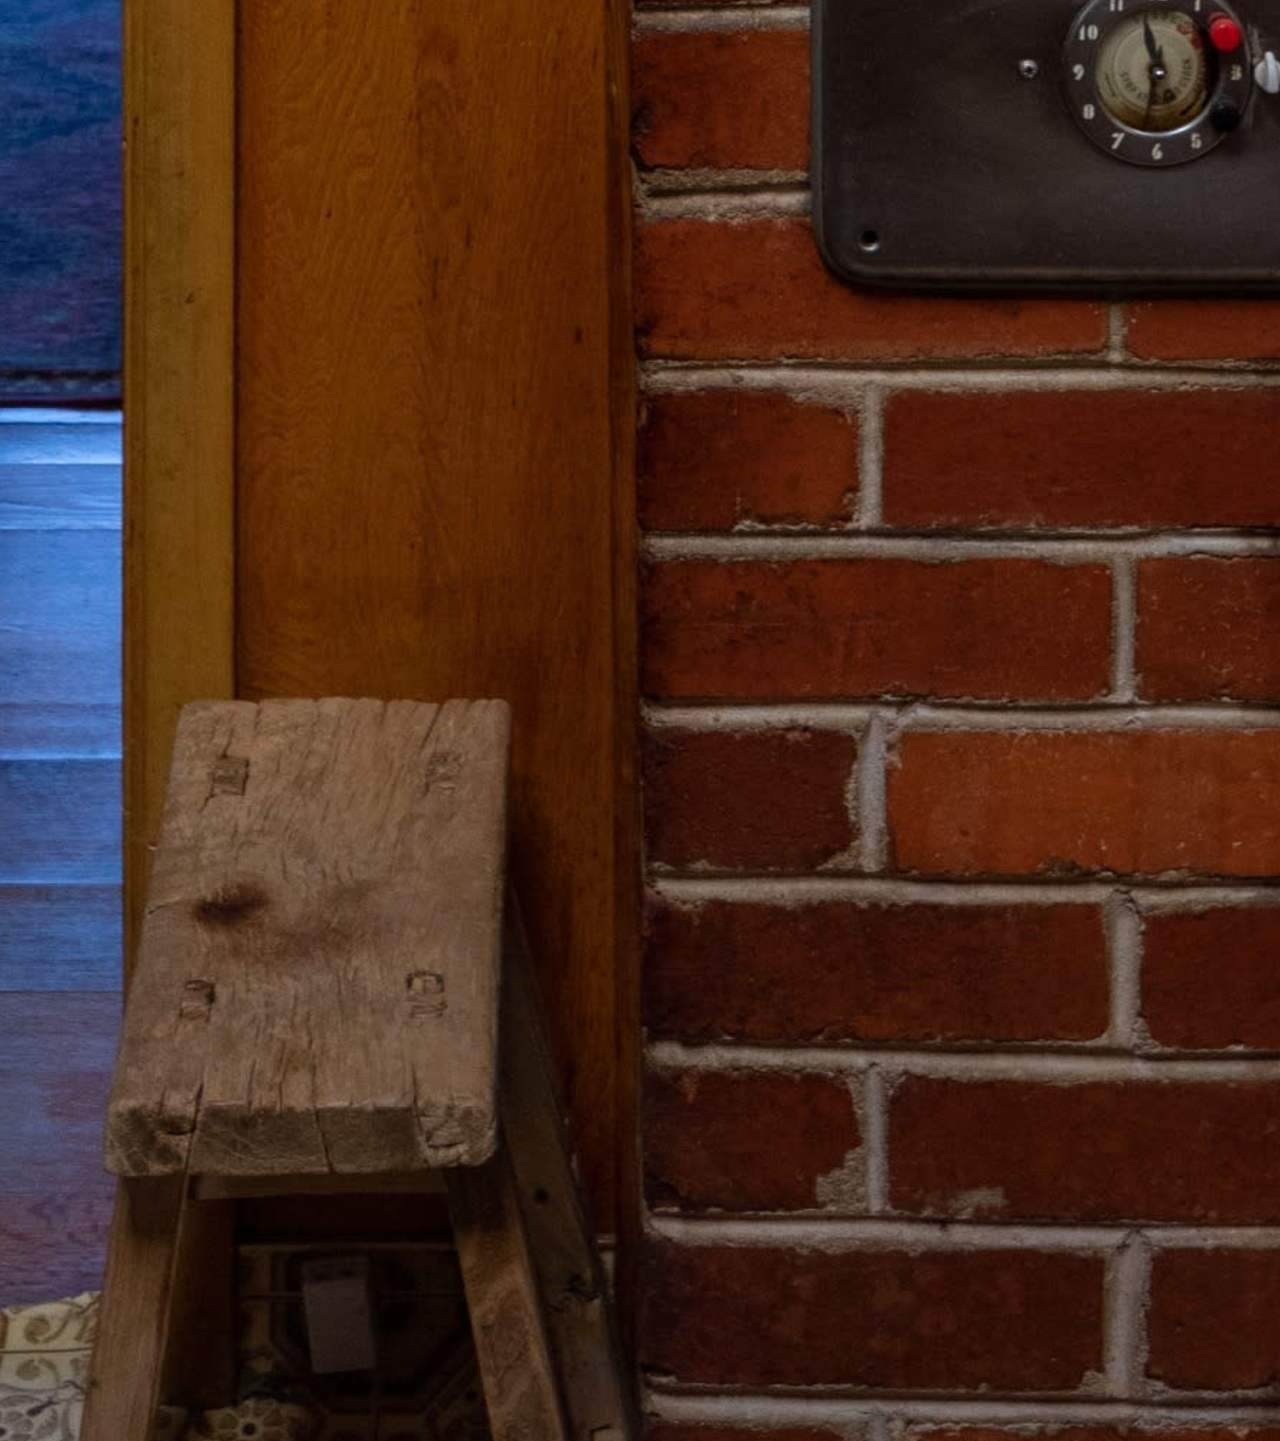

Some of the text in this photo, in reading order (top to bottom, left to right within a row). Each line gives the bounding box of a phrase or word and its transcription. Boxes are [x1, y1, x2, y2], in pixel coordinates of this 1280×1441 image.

[1079, 24, 1099, 41] 10
[1073, 64, 1085, 81] 9
[1083, 104, 1095, 120] 8
[1111, 133, 1125, 149] 7
[1190, 133, 1202, 149] 5
[1151, 142, 1163, 160] 6
